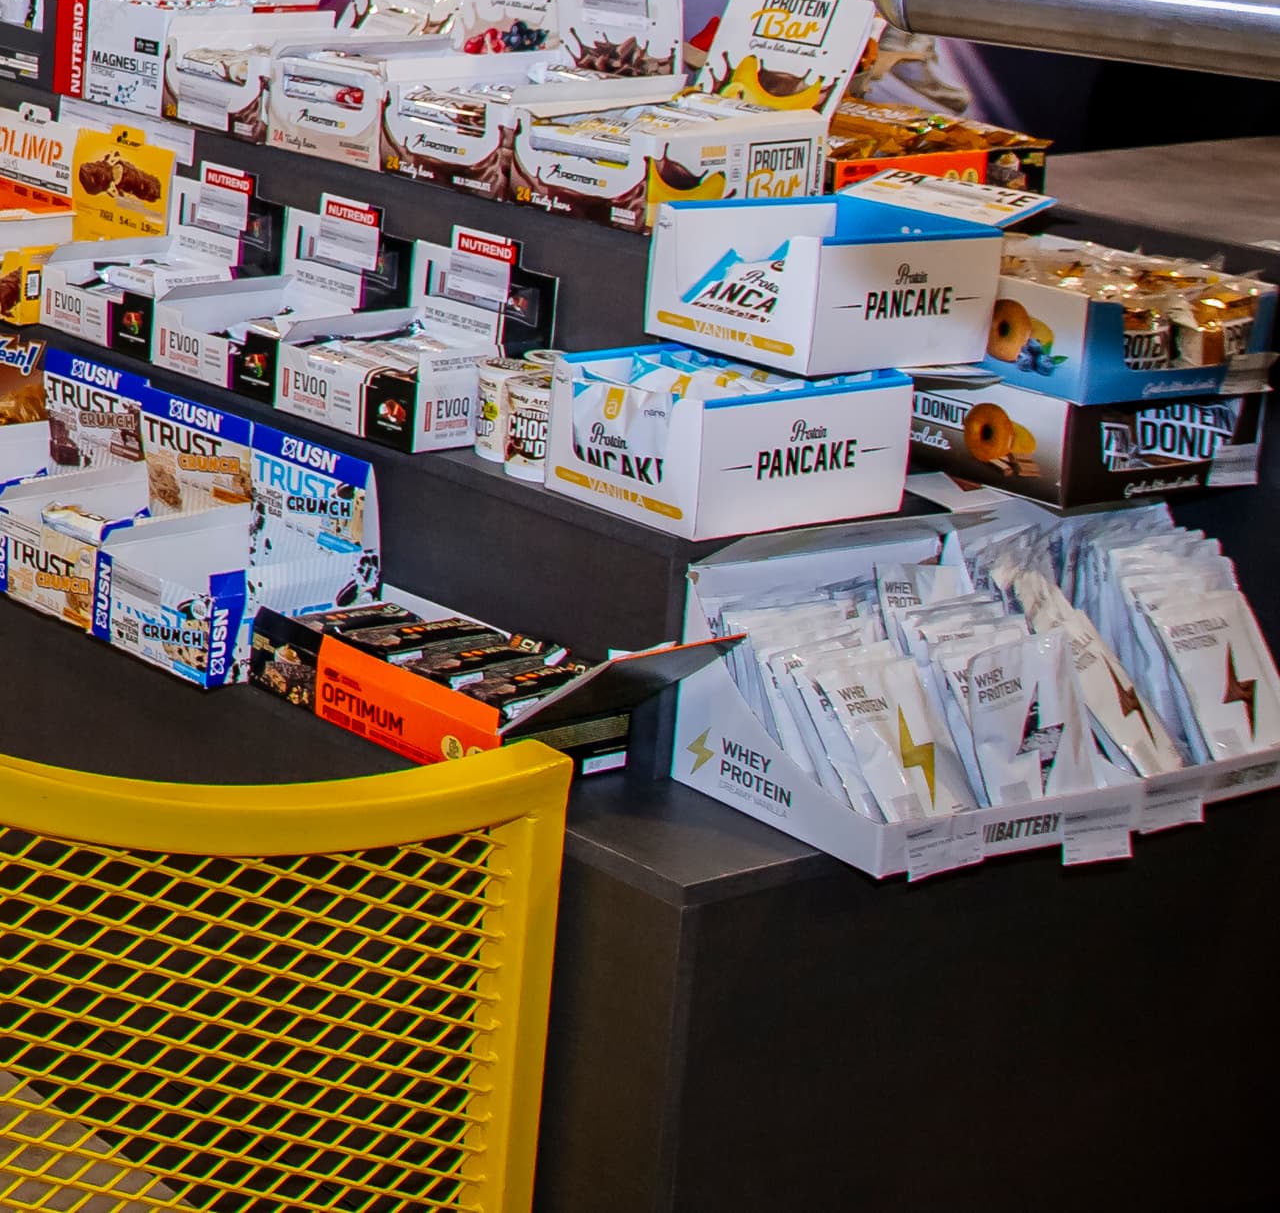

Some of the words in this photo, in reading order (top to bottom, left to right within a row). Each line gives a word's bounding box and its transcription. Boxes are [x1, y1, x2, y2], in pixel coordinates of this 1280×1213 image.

[750, 7, 820, 39] Bar
[69, 2, 85, 94] NUTREND
[91, 50, 159, 76] MAGNESLIFE
[386, 156, 400, 170] 24
[754, 145, 805, 172] PROTEIN
[207, 172, 250, 191] NUTREND
[516, 187, 531, 202] 24
[746, 168, 801, 198] Bar
[327, 201, 375, 224] NUTREND
[460, 238, 513, 260] NUTREND
[54, 290, 82, 315] EVOQ
[864, 286, 954, 321] PANCAKE
[168, 330, 200, 357] EVOQ
[692, 319, 754, 347] VANILLA
[84, 363, 119, 390] USN
[293, 370, 328, 400] EVOQ
[47, 375, 119, 413] TRUST
[79, 410, 136, 430] CRUNCH
[184, 404, 222, 433] USN
[436, 397, 470, 419] EVOQ
[143, 415, 222, 457] TRUST
[508, 414, 549, 441] CHOC
[589, 421, 629, 450] Protein
[790, 418, 828, 443] Protein
[1141, 421, 1215, 460] DONU
[178, 453, 241, 476] CRUNCH
[296, 440, 338, 474] USN
[755, 438, 859, 482] PANCAKE
[254, 454, 336, 499] TRUST
[268, 507, 283, 518] BAR
[286, 495, 353, 520] CRUNCH
[10, 540, 75, 577] TRUST
[36, 571, 91, 595] CRUNCH
[96, 562, 112, 610] USN
[142, 624, 203, 647] CRUNCH
[210, 609, 229, 658] USN
[974, 667, 1004, 689] WHEY
[978, 677, 1023, 704] PROTEIN
[838, 685, 867, 702] WHEY
[846, 697, 889, 717] PROTEIN
[321, 682, 404, 736] OPTIMUM
[722, 737, 772, 774] WHEY
[719, 758, 792, 808] PROTEIN
[993, 812, 1062, 843] BATTERY
